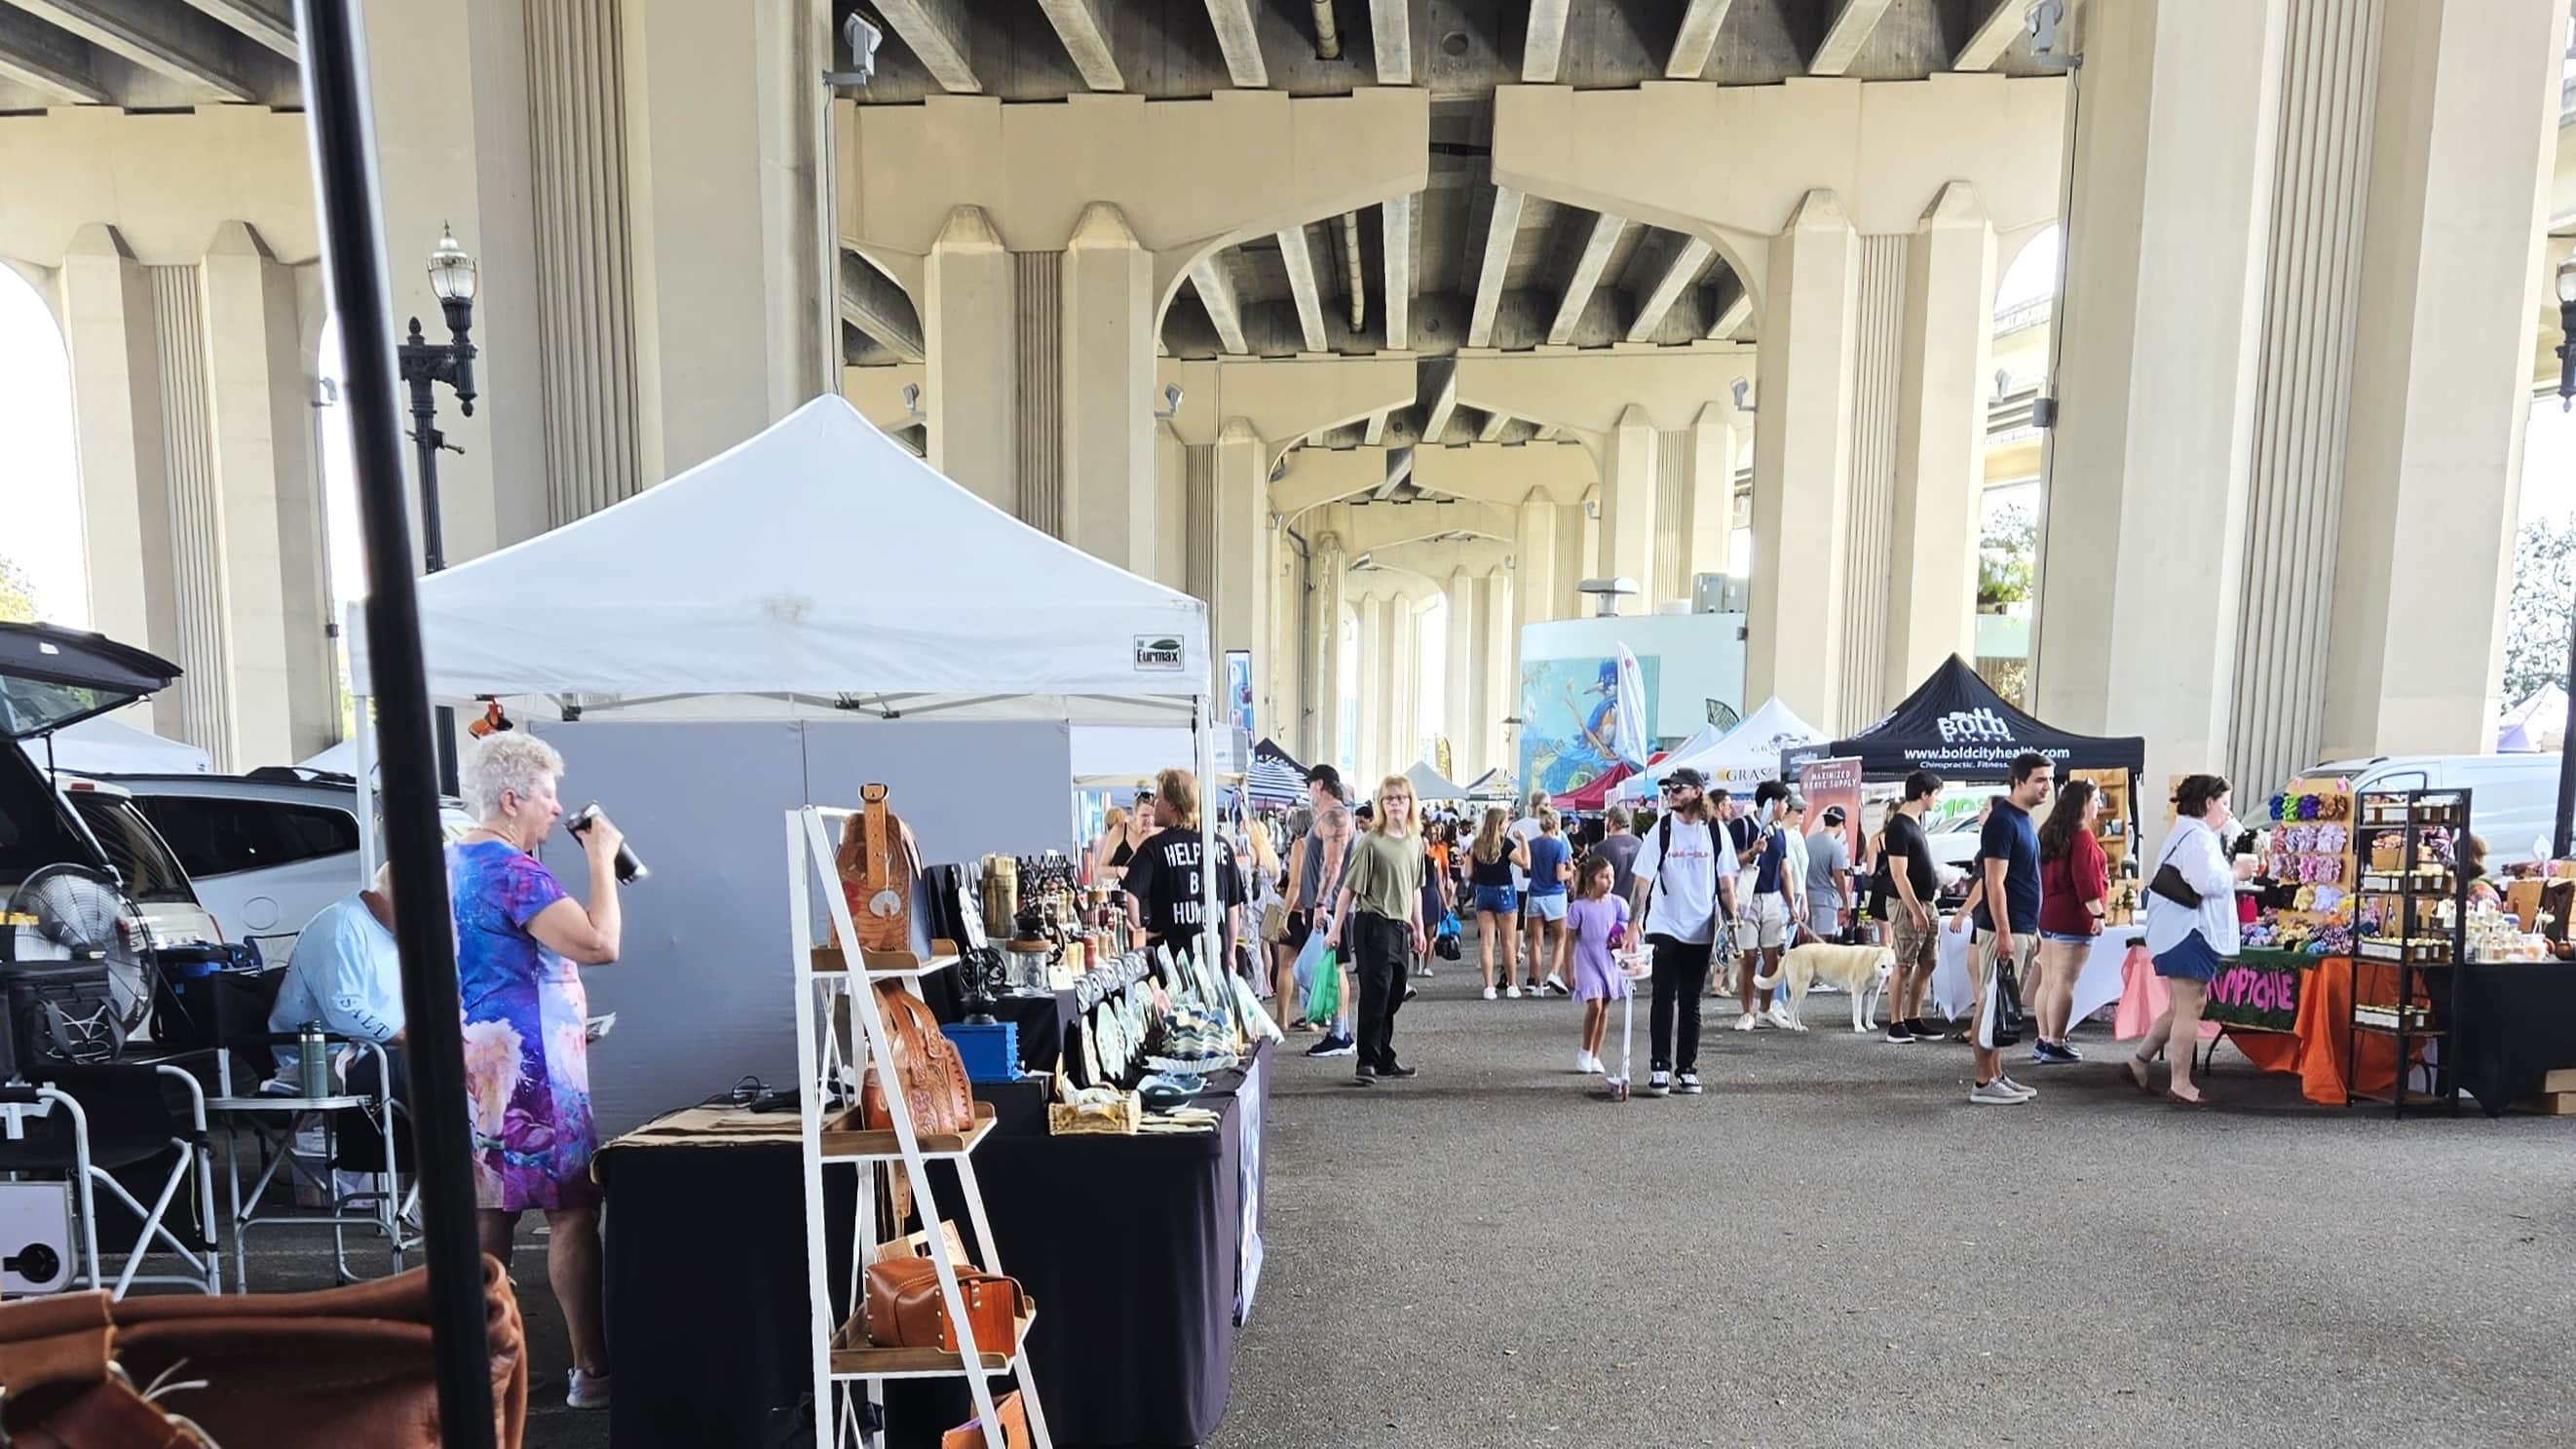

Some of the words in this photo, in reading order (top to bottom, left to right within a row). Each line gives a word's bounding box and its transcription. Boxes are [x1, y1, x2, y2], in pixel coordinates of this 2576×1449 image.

[1904, 745, 2070, 761] www.boldcityhealthcom
[1830, 778, 1857, 788] SUPPLY
[1163, 842, 1201, 867] HELP
[1173, 899, 1226, 925] HUMN
